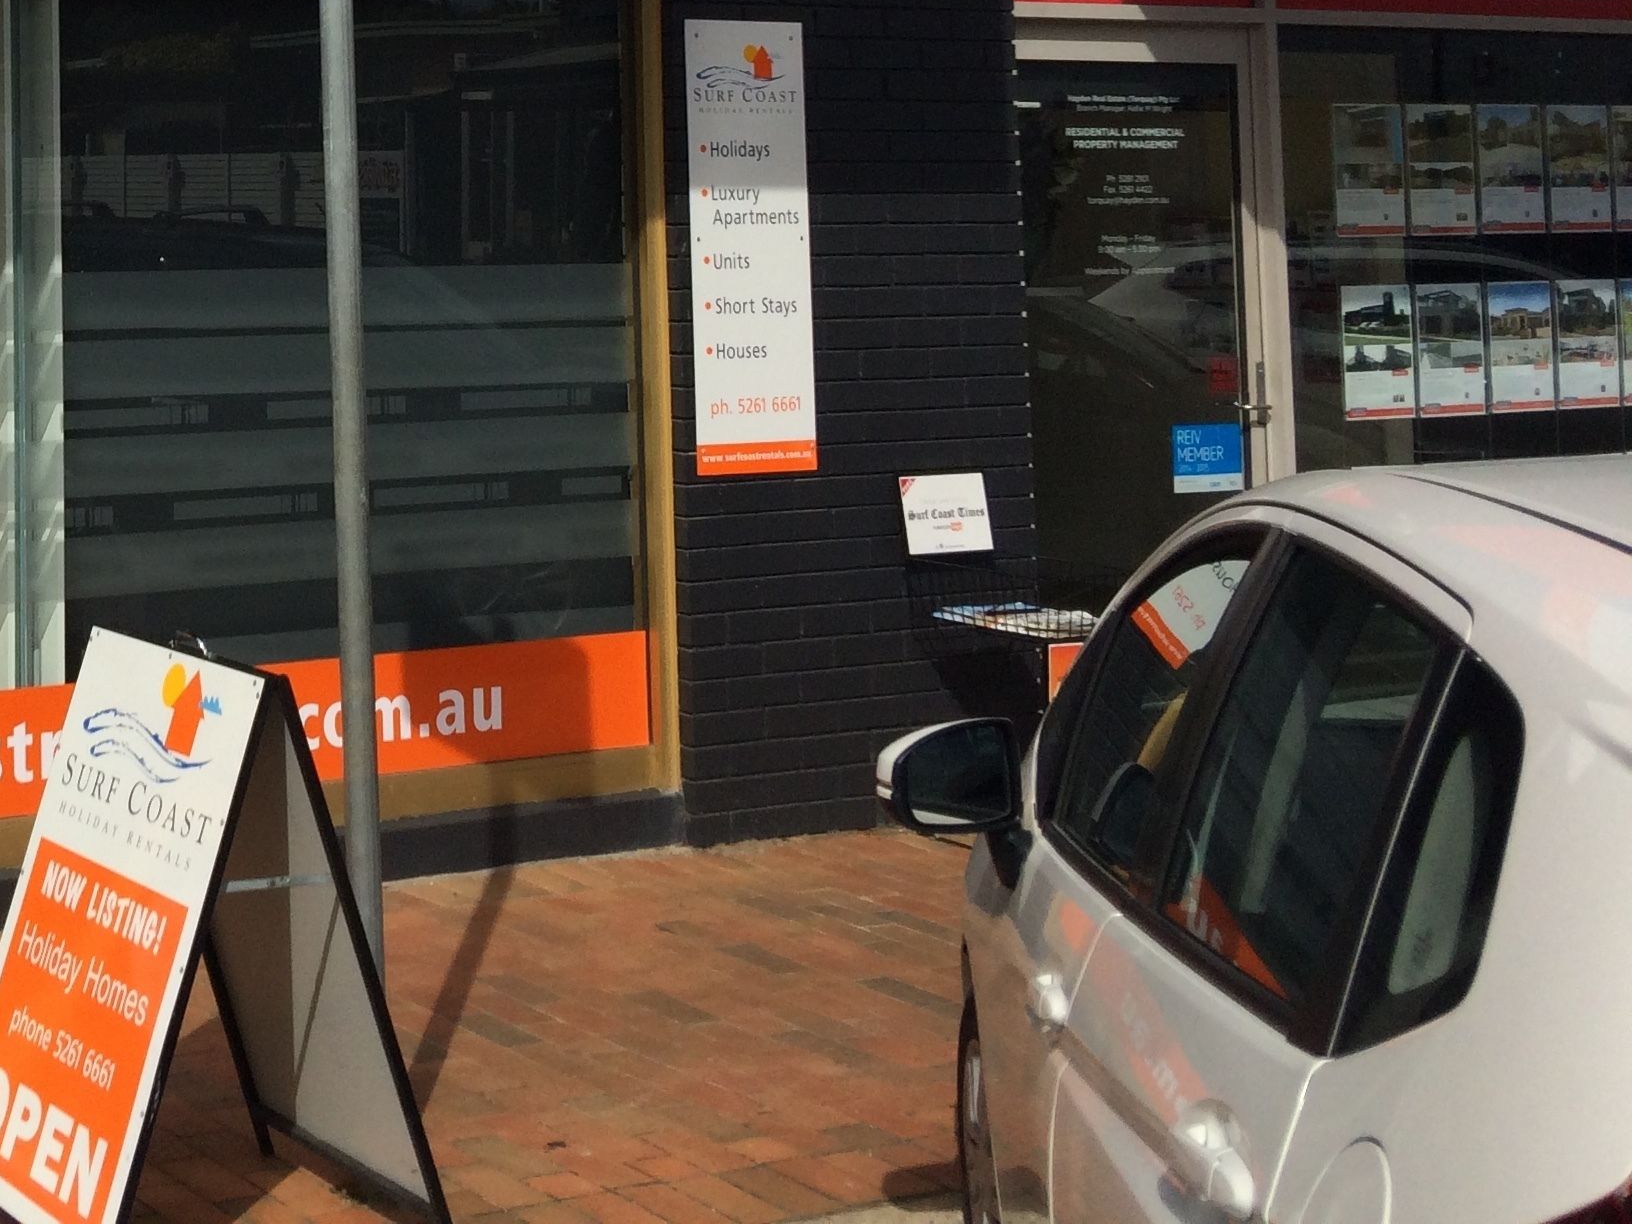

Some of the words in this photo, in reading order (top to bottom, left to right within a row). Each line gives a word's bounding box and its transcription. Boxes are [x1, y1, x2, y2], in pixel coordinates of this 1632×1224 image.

[693, 88, 734, 102] SURF
[743, 88, 797, 103] COAST
[710, 141, 770, 161] Holidays
[711, 185, 760, 205] Luxury
[713, 209, 799, 229] Apartments
[713, 252, 750, 269] Units
[715, 297, 755, 314] Short
[762, 297, 797, 317] Stays
[716, 343, 767, 359] Houses
[710, 399, 733, 418] ph.
[738, 398, 766, 413] 5261
[772, 396, 802, 412] 6661
[1177, 446, 1224, 462] MEMBER
[908, 509, 929, 522] Surf
[931, 508, 956, 520] Coast
[958, 506, 985, 519] Times
[61, 753, 122, 803] SURF
[128, 781, 212, 845] COAST
[59, 800, 120, 842] HOLIDAY
[127, 830, 192, 871] RENTALS
[41, 859, 85, 912] NOW
[87, 884, 166, 955] LISTING!
[17, 920, 83, 994] Holiday
[83, 957, 150, 1026] Homes
[8, 1006, 52, 1053] phone
[53, 1030, 85, 1072] 5261
[83, 1052, 117, 1093] 6661
